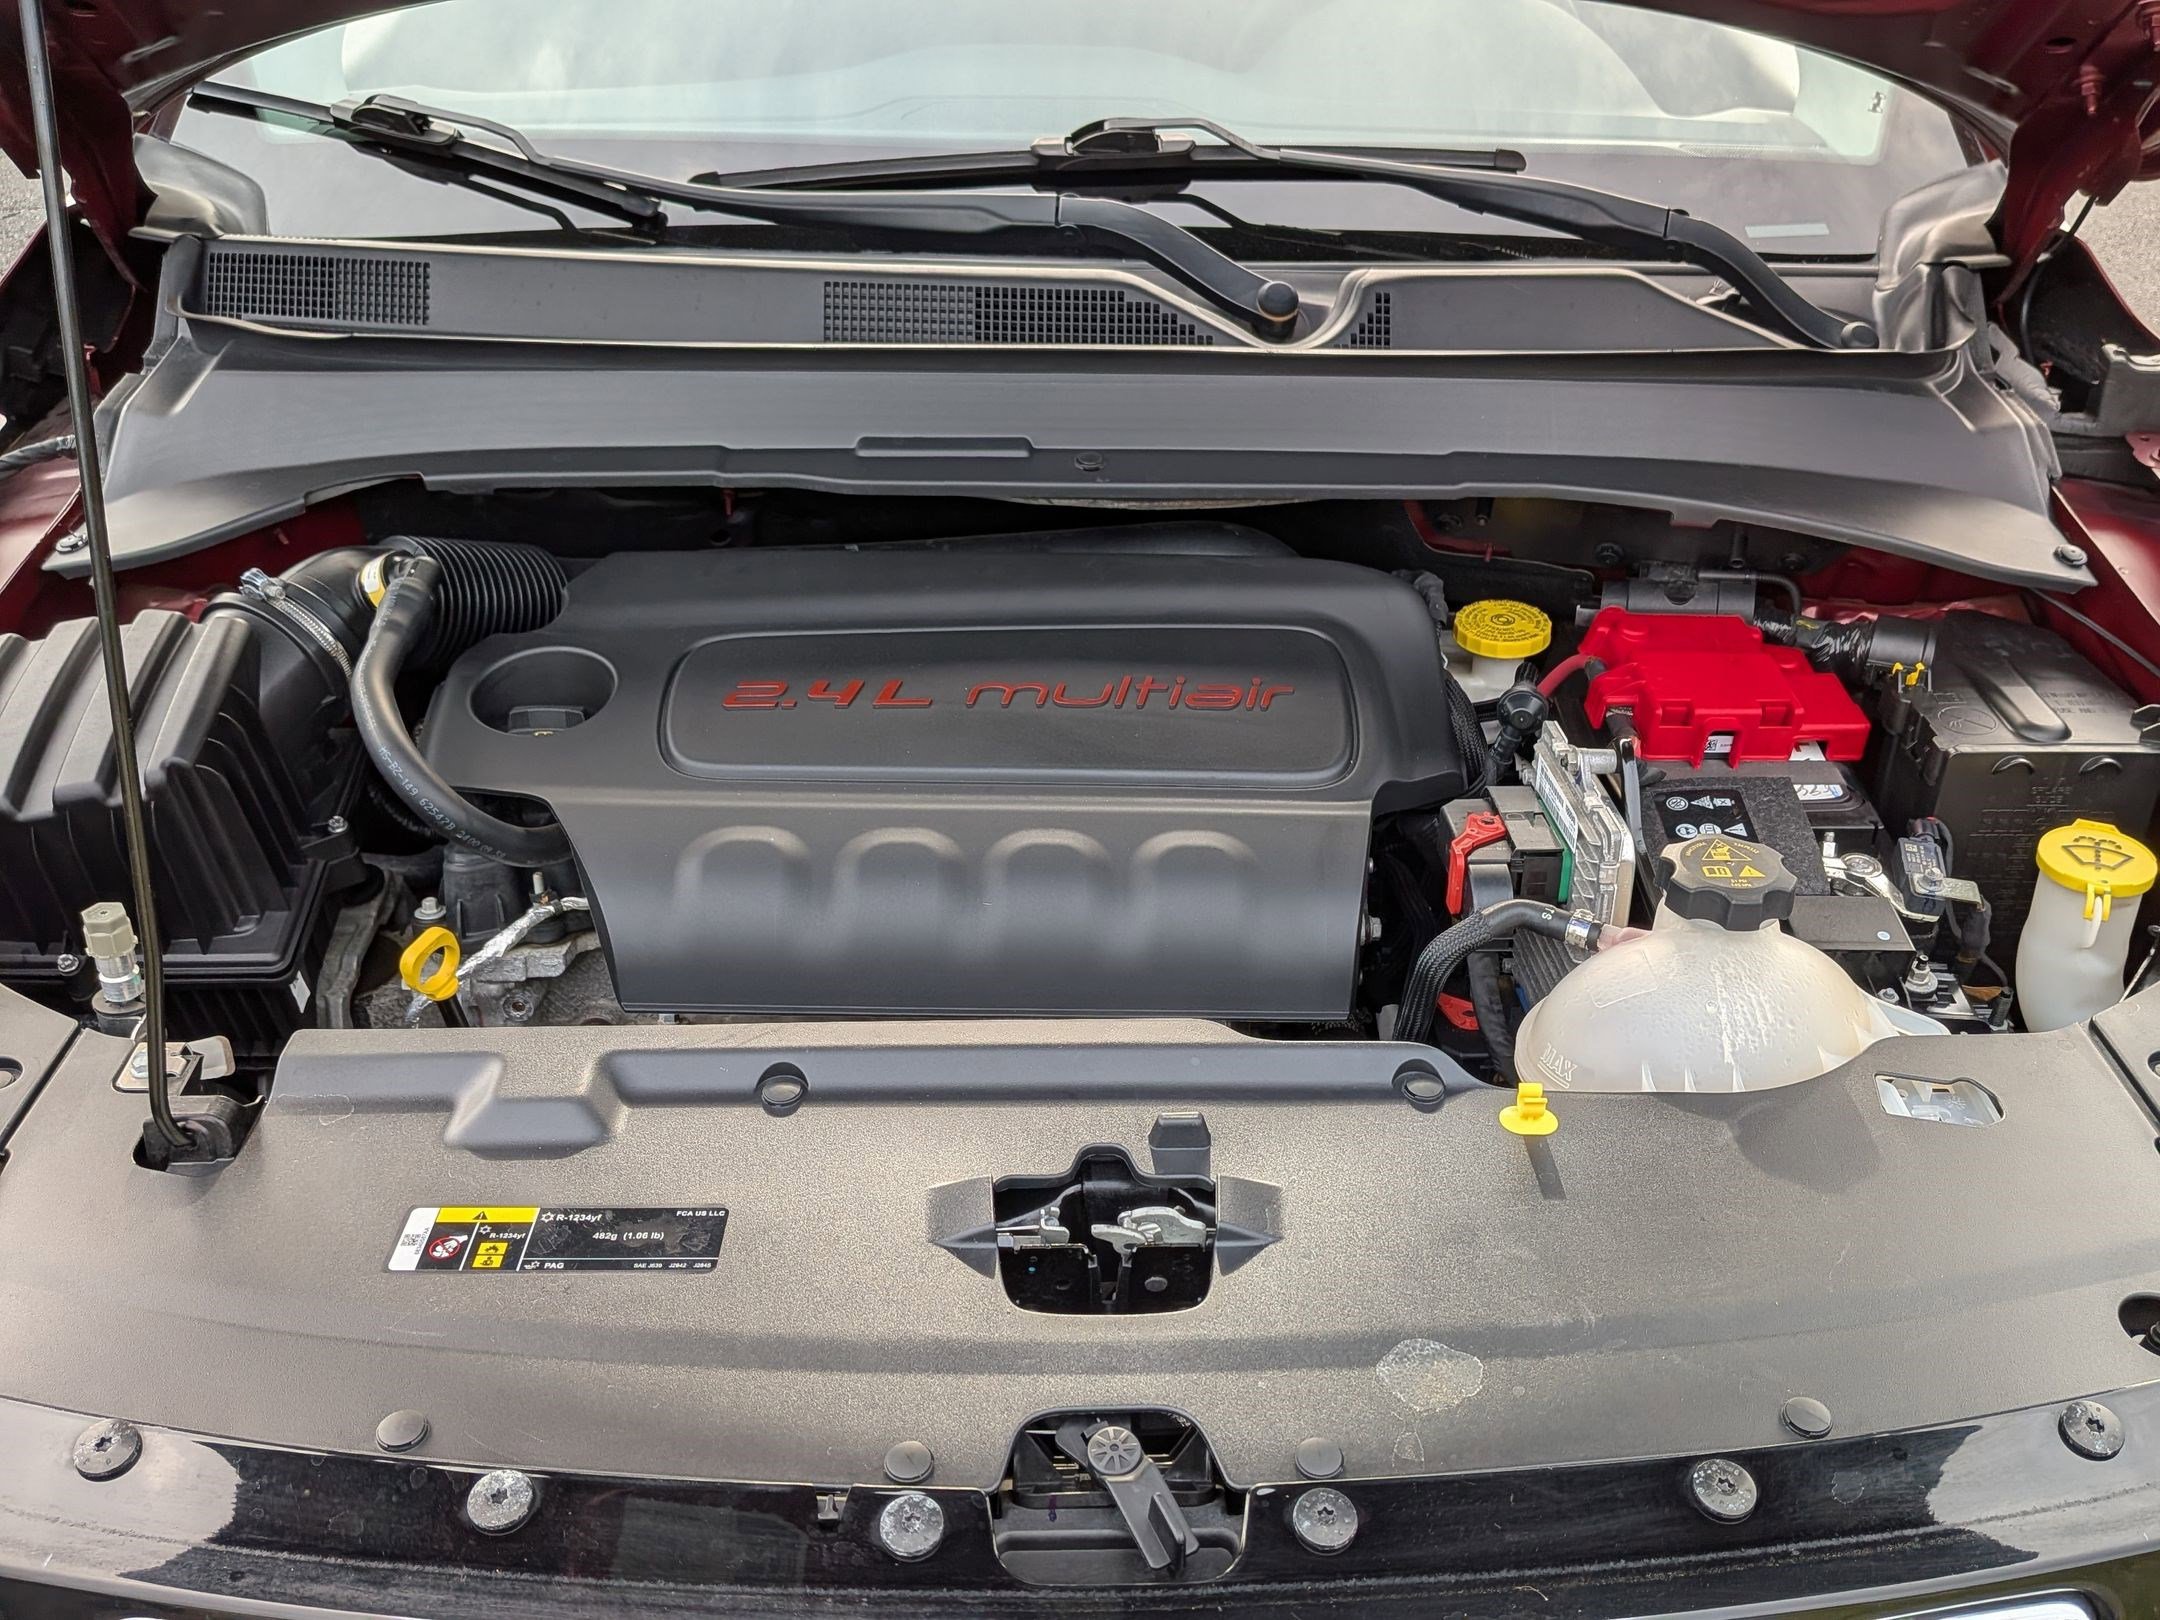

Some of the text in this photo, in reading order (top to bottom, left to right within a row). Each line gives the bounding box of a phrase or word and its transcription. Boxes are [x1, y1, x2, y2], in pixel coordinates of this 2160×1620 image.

[721, 674, 1295, 712] 2.4L multiair
[556, 1213, 602, 1223] R-1234yf
[489, 1232, 526, 1240] R-1234yf
[592, 1231, 665, 1241] 482g (1.06 lb)
